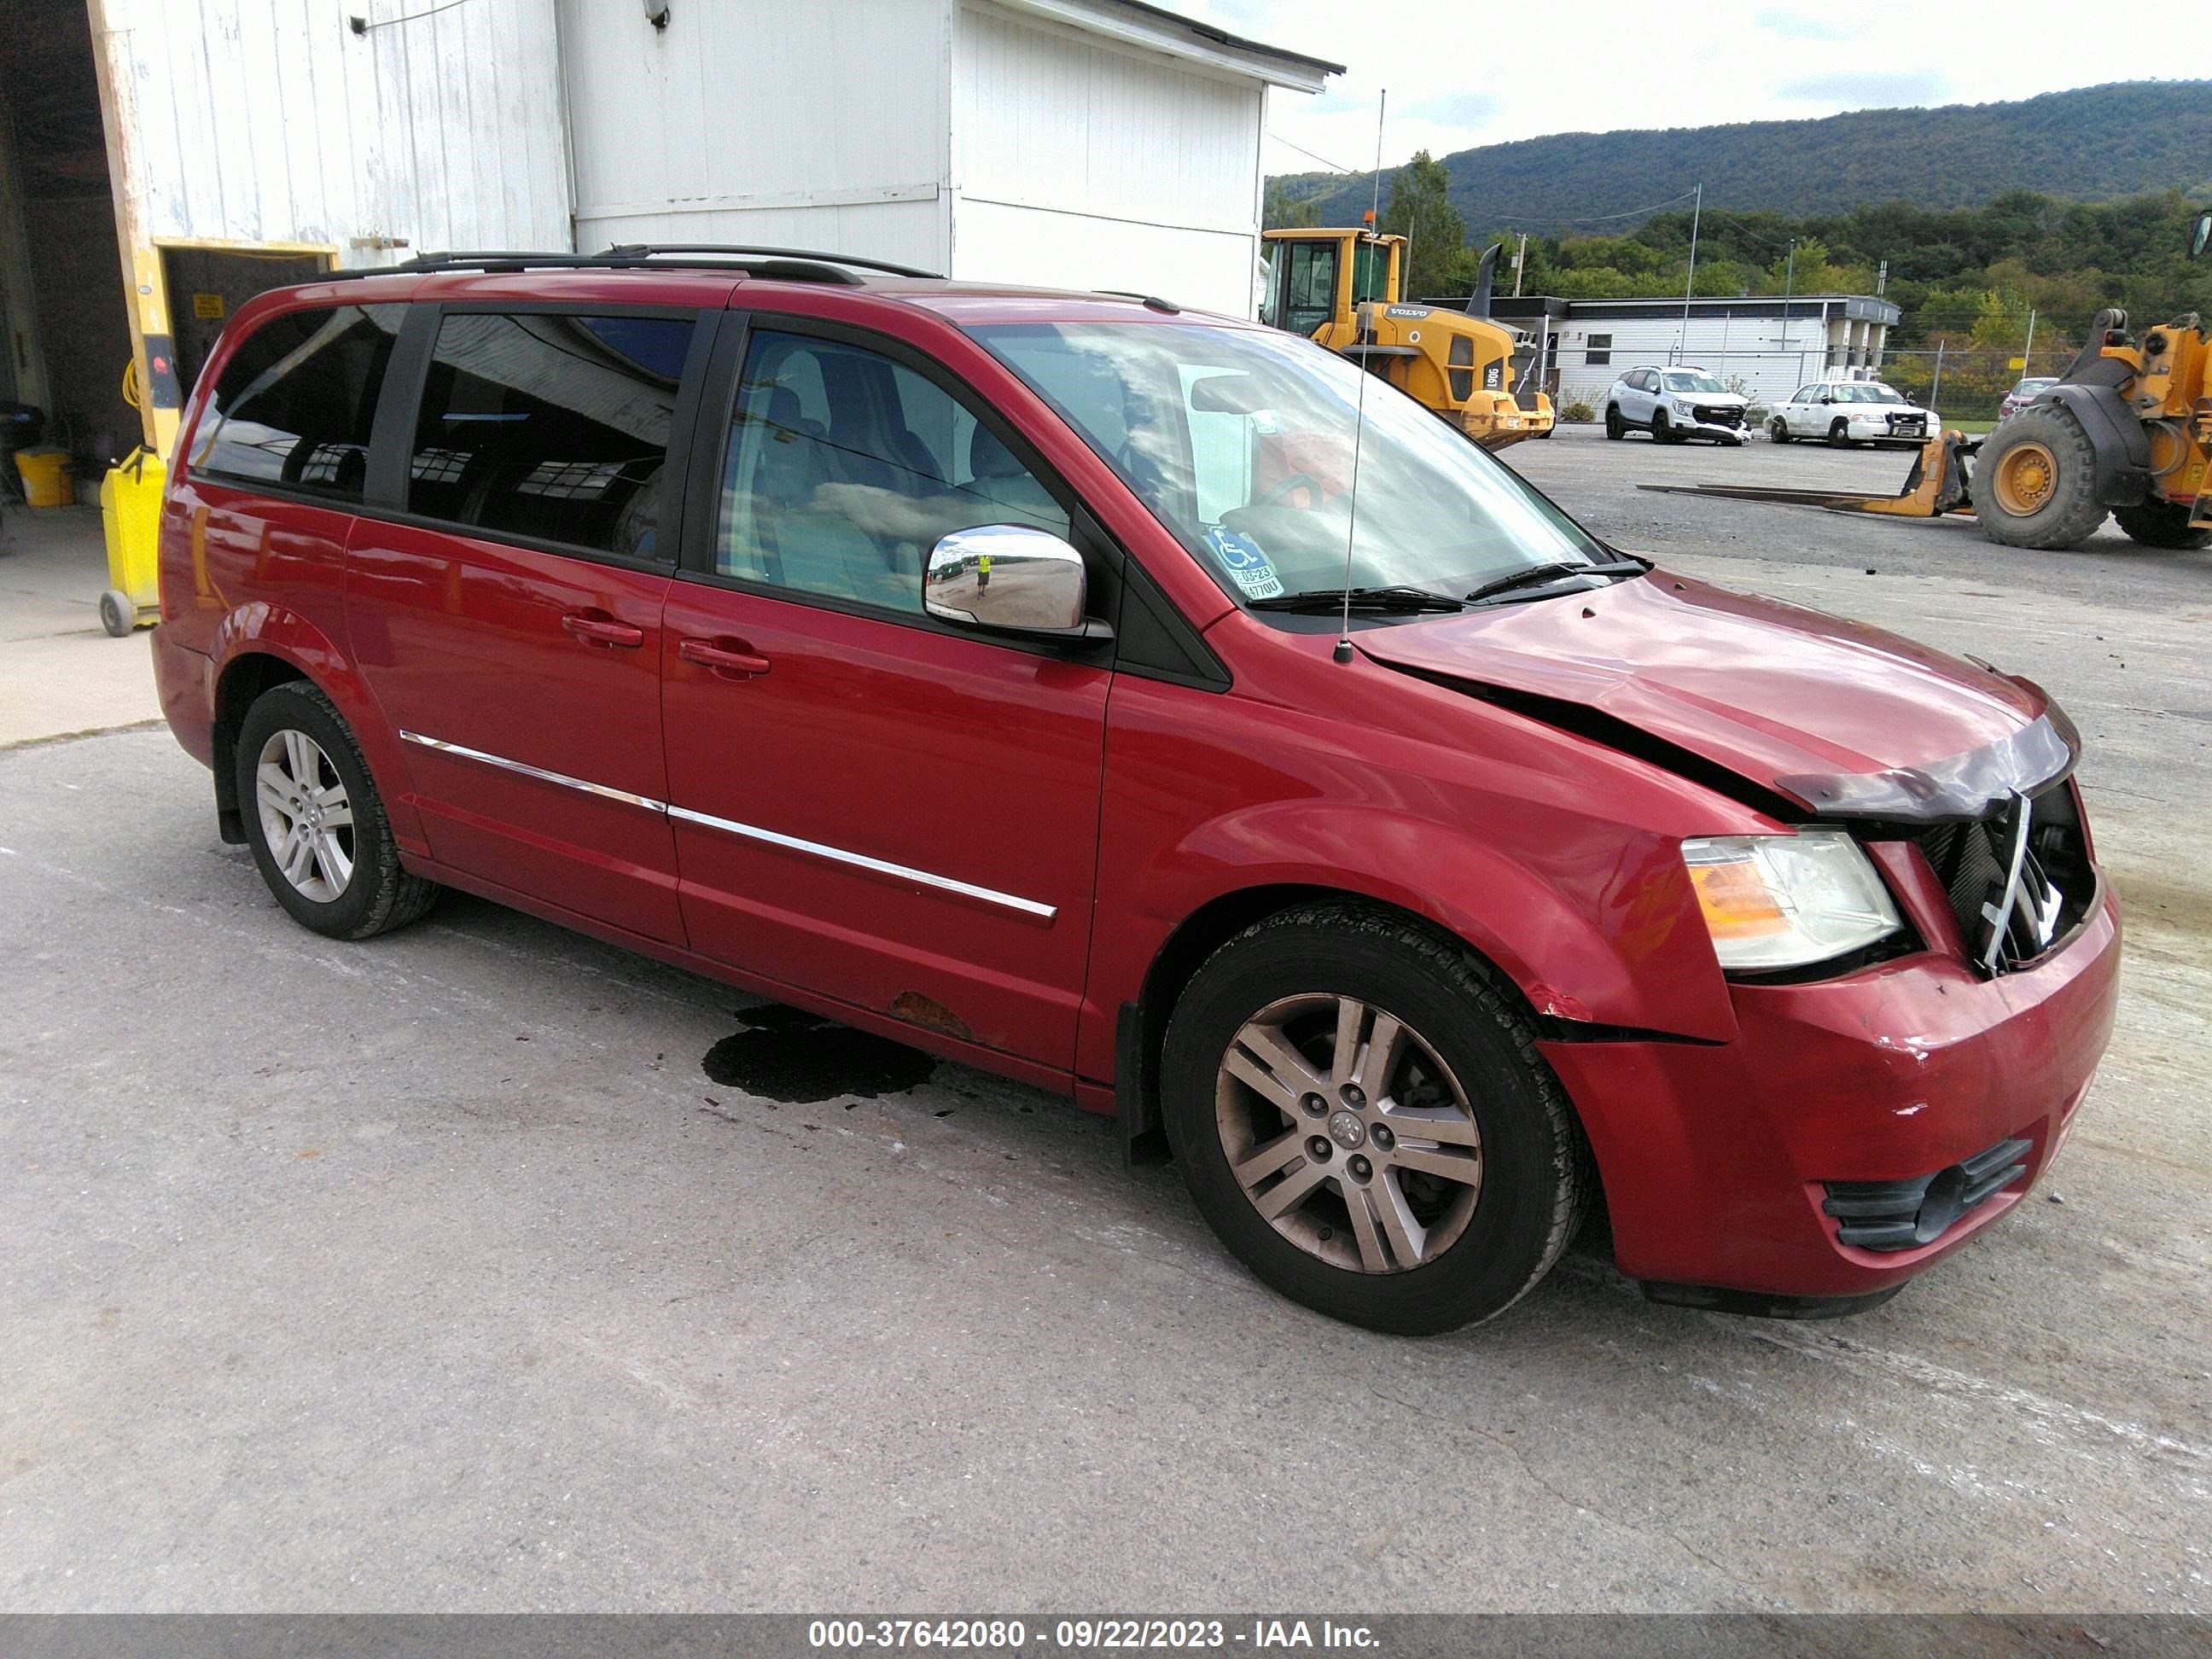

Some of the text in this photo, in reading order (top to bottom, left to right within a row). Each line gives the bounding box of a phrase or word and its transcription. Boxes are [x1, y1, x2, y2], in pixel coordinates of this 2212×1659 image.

[1390, 308, 1428, 317] VOLVO
[1487, 368, 1499, 387] L90G
[1241, 567, 1271, 582] 03-23
